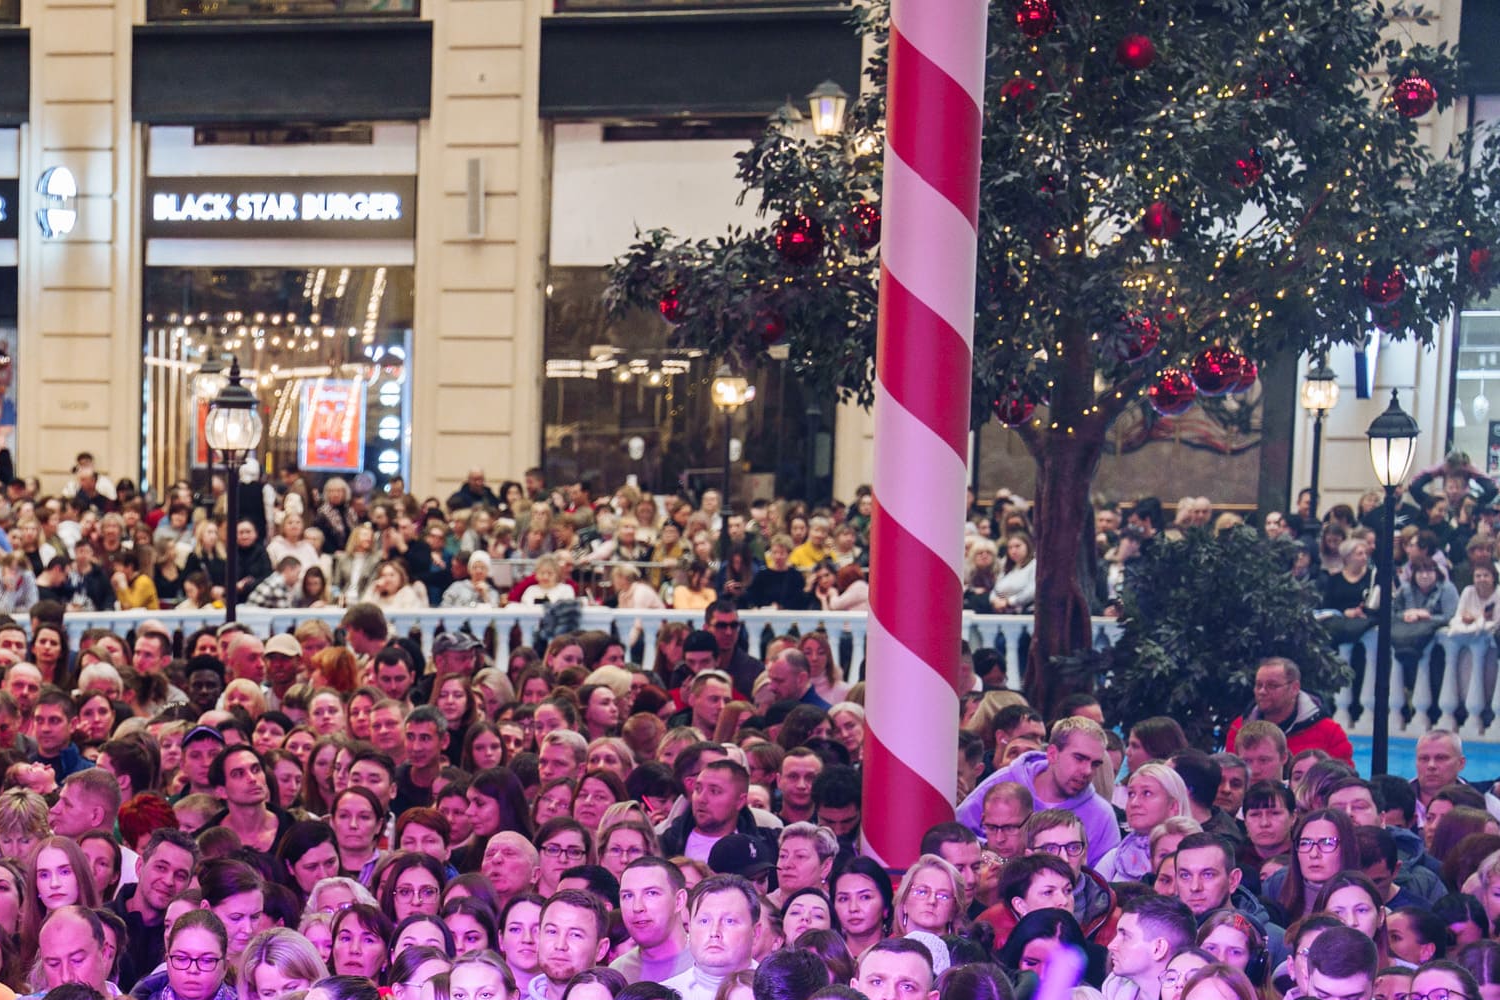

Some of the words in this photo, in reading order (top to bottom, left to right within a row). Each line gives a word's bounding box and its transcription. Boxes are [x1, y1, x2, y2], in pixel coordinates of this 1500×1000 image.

[153, 193, 233, 221] BLACK
[235, 193, 300, 221] STAR
[301, 193, 402, 221] BURGER
